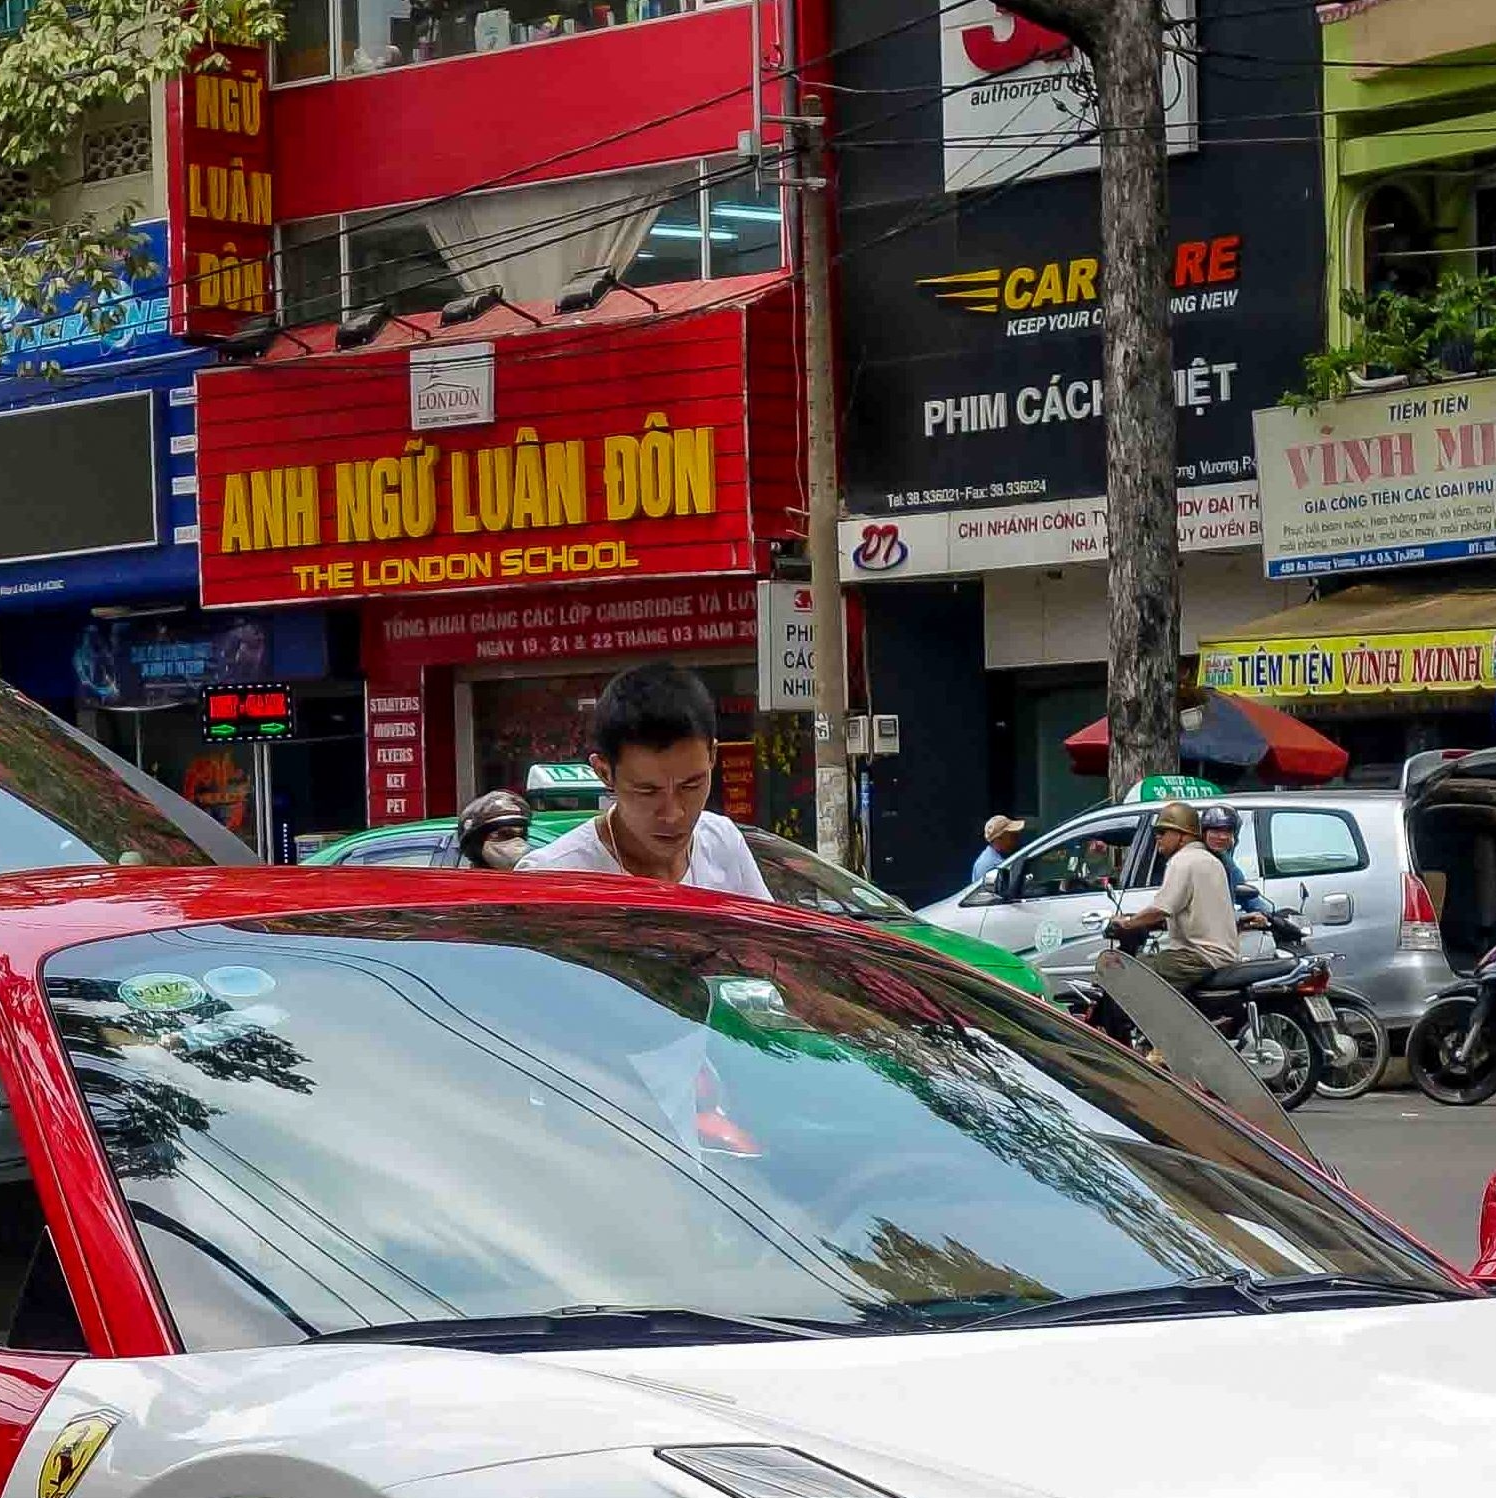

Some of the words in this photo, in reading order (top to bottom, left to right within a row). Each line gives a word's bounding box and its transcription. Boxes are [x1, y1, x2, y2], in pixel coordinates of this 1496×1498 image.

[971, 76, 1062, 106] authorized
[189, 157, 272, 226] LUÂN
[1004, 257, 1099, 311] CAR
[1007, 316, 1047, 337] KEEP
[1048, 312, 1091, 331] YOUR
[1201, 289, 1240, 311] NEW
[418, 388, 480, 410] LONDON
[924, 391, 1008, 437] PHIM
[1174, 357, 1238, 416] IỆT
[221, 464, 321, 554] ANH
[336, 437, 440, 543] NGỮ
[450, 426, 586, 533] LUÂN
[603, 412, 716, 520] ĐÔN
[1304, 499, 1330, 514] GIA
[958, 521, 984, 539] CHI
[293, 561, 357, 591] THE
[363, 550, 493, 587] LONDON
[499, 540, 639, 576] SCHOOL
[596, 594, 693, 623] CAMBRIDGE
[1412, 645, 1483, 683] MINH
[377, 748, 414, 763] FLYERS
[387, 799, 407, 814] PET
